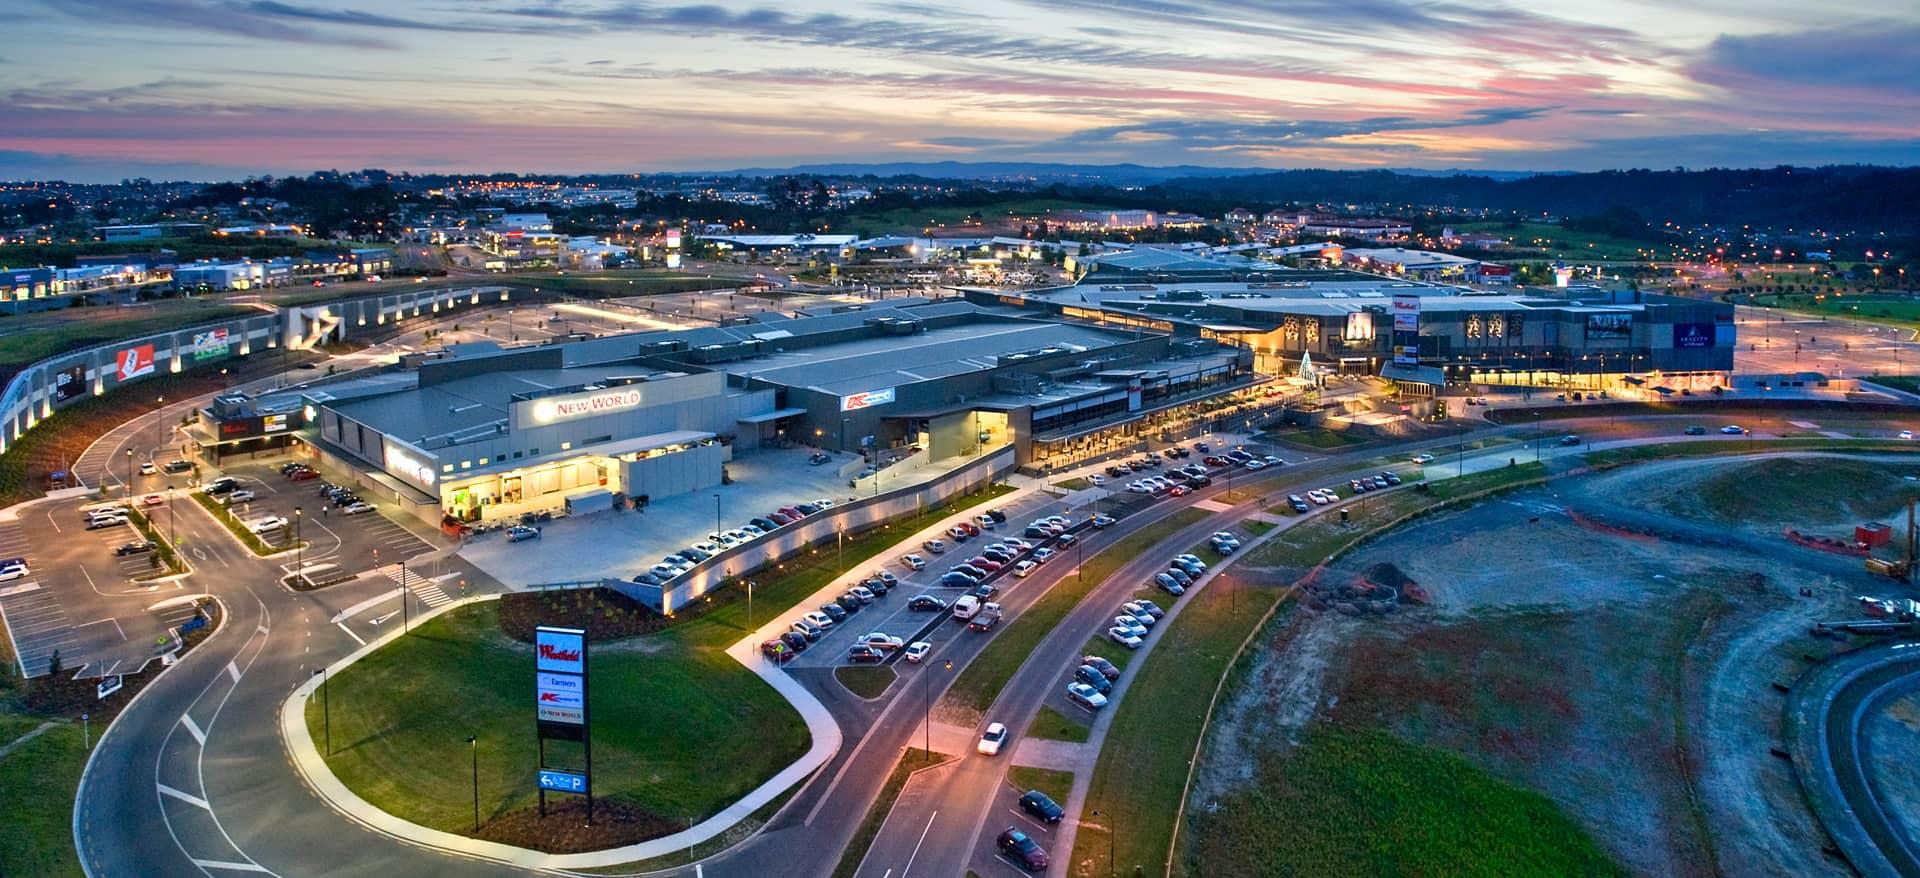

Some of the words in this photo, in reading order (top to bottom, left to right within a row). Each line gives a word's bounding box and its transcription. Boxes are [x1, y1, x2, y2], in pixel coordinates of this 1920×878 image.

[557, 401, 588, 415] NEW
[592, 393, 639, 409] WORLD
[539, 644, 580, 662] Westfield
[552, 678, 576, 688] Farmers
[573, 777, 581, 790] P
